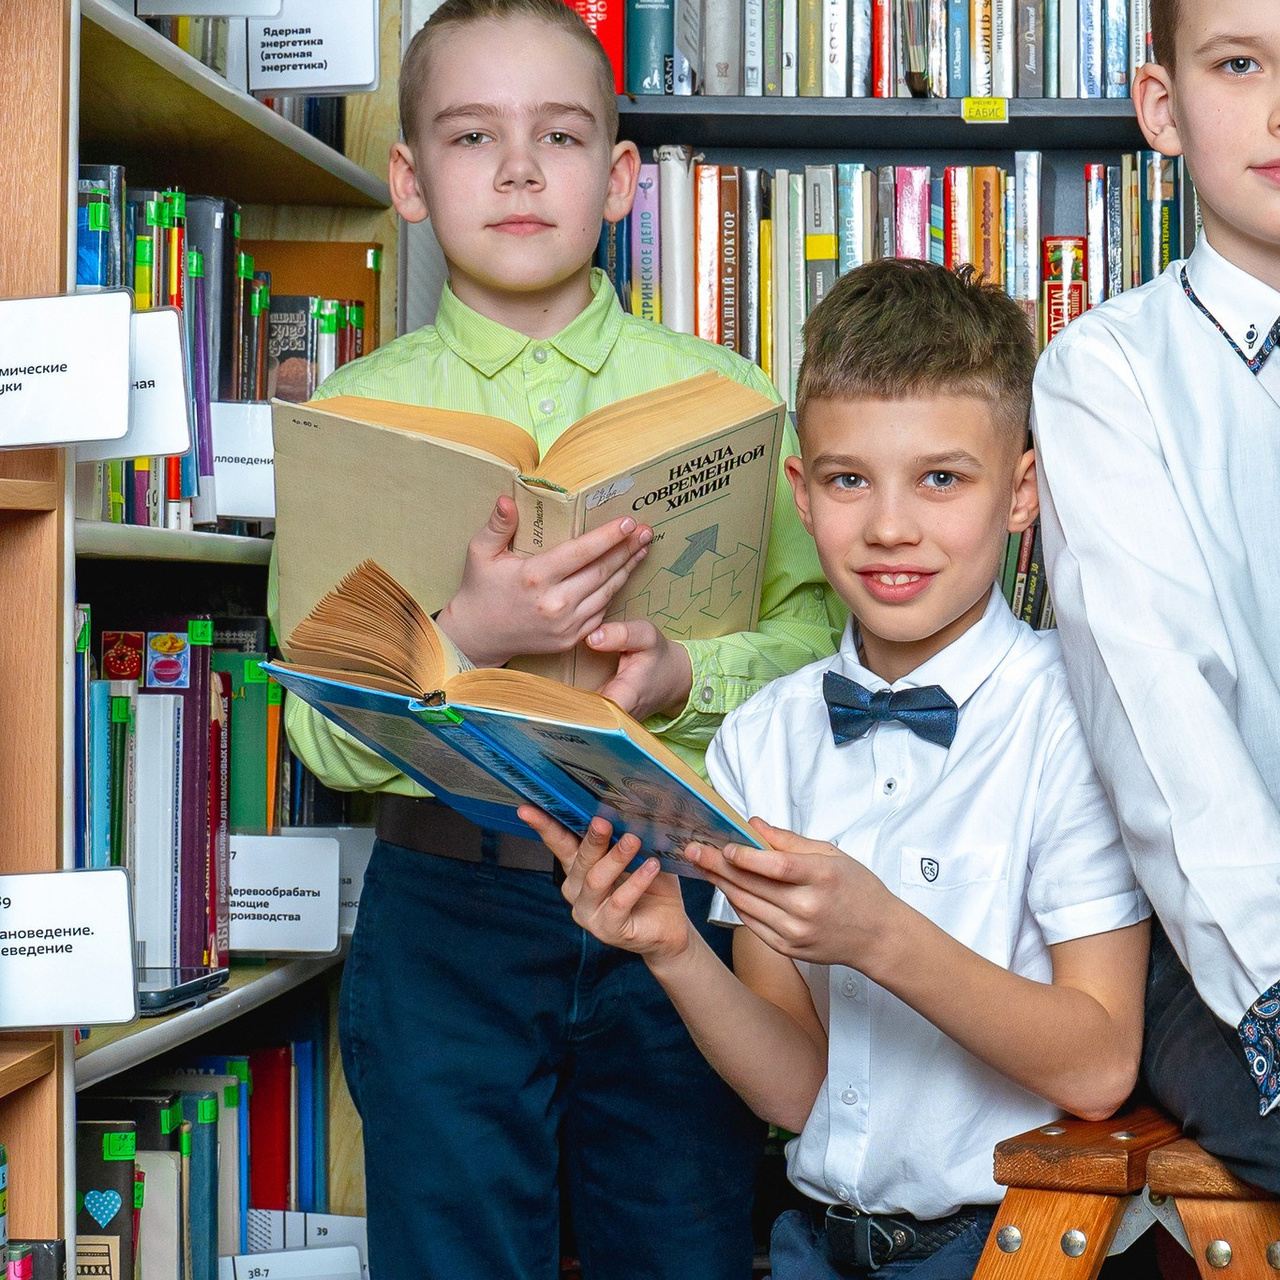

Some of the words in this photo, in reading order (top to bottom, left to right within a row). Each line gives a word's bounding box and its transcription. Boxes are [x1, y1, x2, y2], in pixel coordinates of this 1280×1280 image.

[262, 26, 312, 37] Ядерная
[260, 36, 324, 48] энергетика
[260, 49, 312, 61] (атомная
[260, 59, 328, 73] энергетика)
[968, 109, 1000, 118] ЕАБИС
[0, 362, 67, 376] мические
[668, 445, 734, 480] НАЧАЛА
[631, 443, 766, 511] СОВРЕМЕННОЙ
[666, 474, 732, 513] ХИМИИ
[0, 925, 95, 939] ановедение.
[216, 913, 230, 953] ББК
[1, 943, 73, 957] еведение
[316, 1227, 328, 1236] 39
[248, 1267, 270, 1279] 38.7
